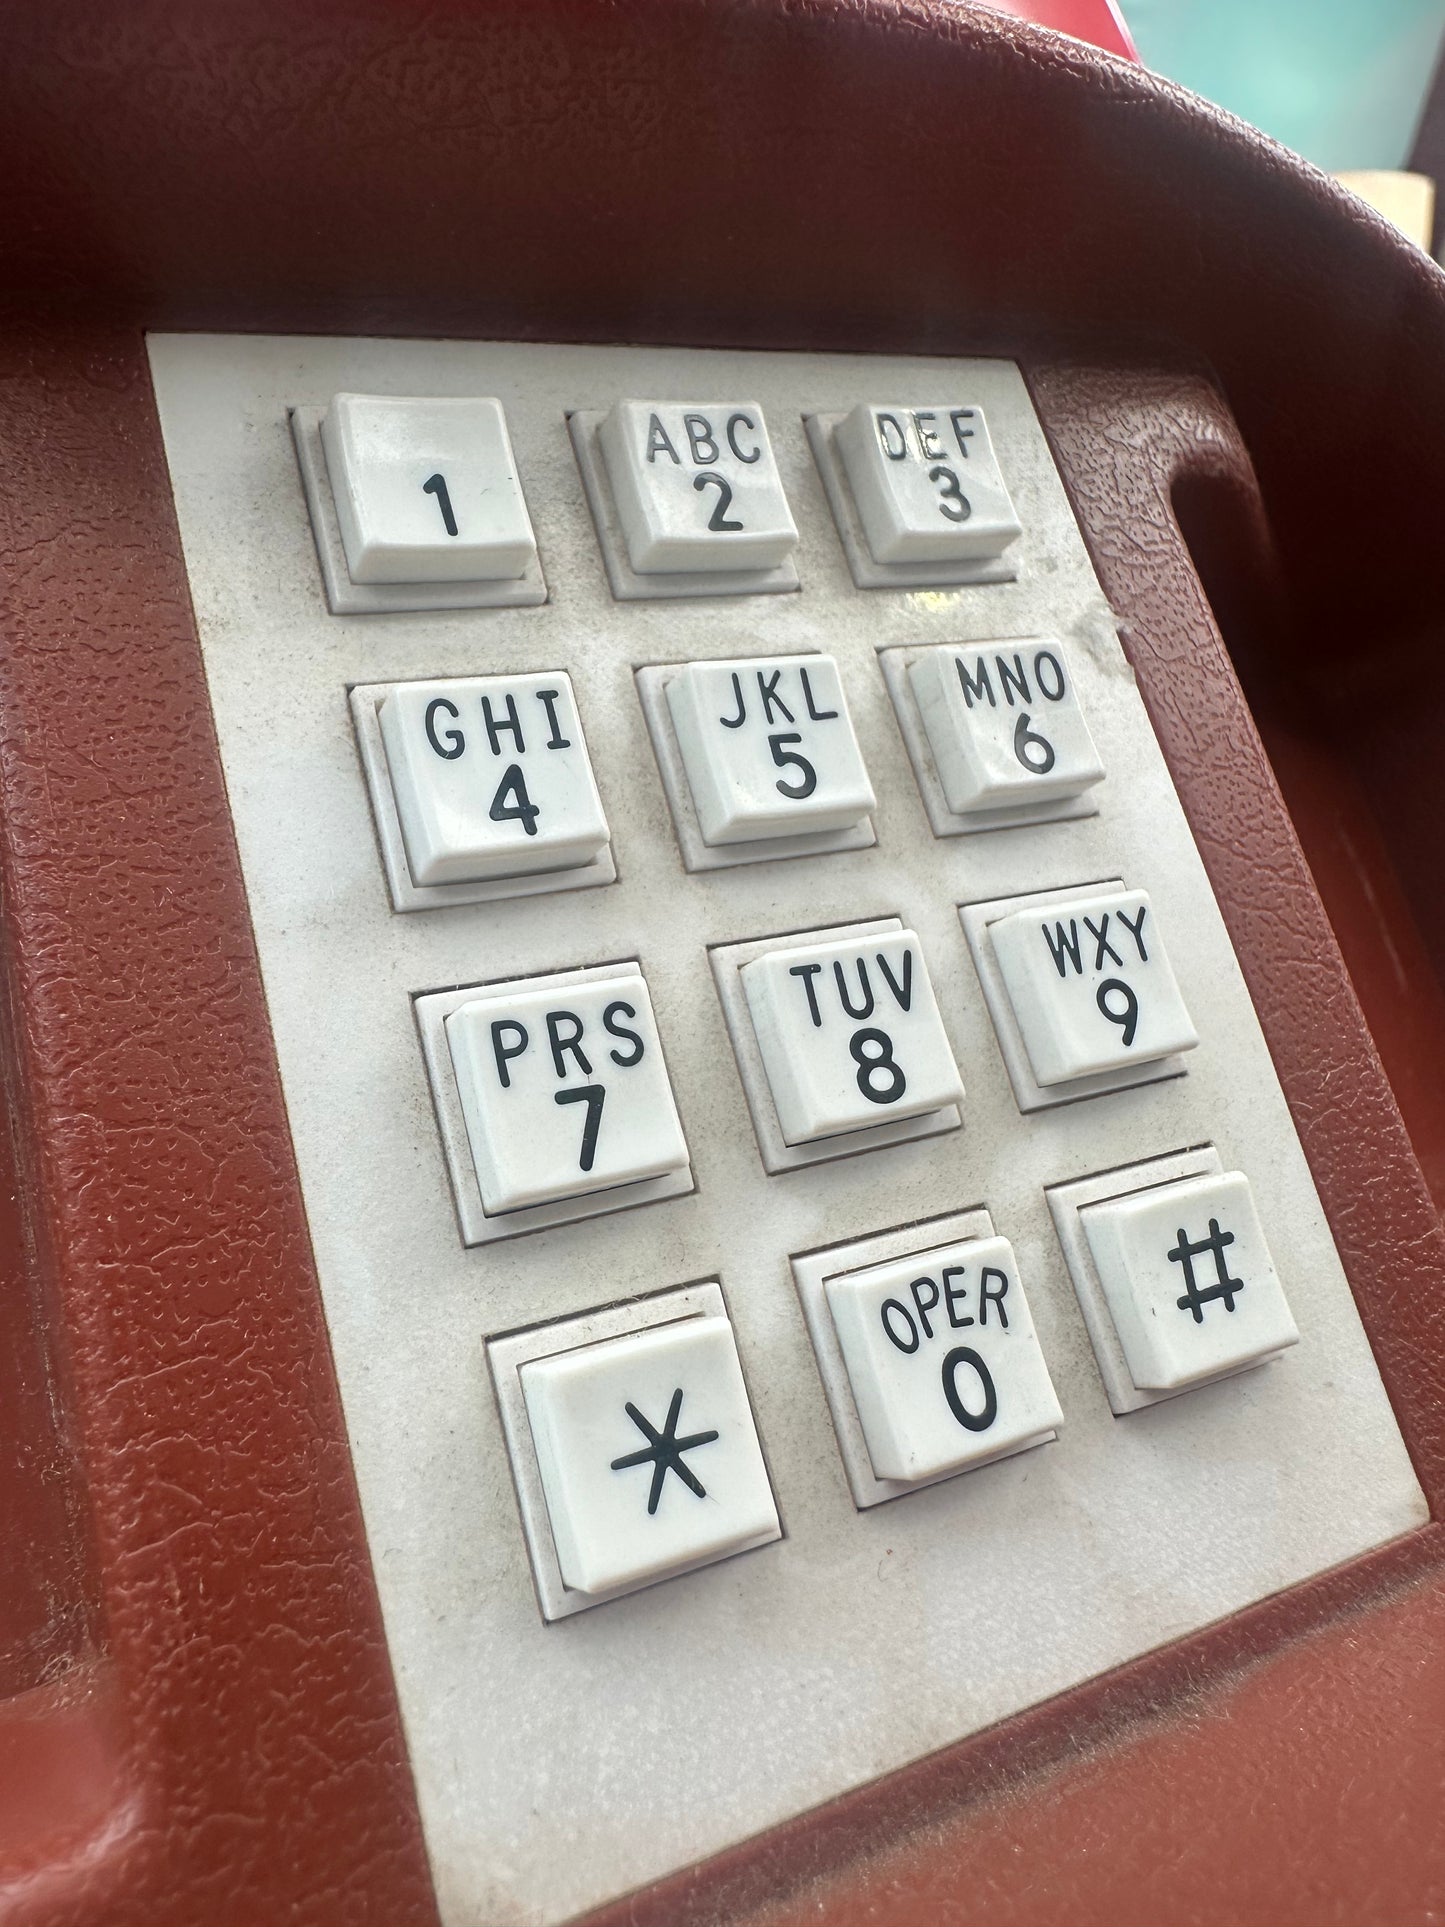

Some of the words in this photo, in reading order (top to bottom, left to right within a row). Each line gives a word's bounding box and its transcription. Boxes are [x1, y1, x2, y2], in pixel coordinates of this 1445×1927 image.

[646, 412, 761, 466] ABC
[876, 409, 975, 461] DEF
[422, 473, 459, 537] 1
[692, 472, 744, 532] 2
[927, 465, 972, 523] 3
[719, 667, 839, 728] JKL
[954, 650, 1066, 709] MNO
[424, 689, 571, 761] GHI
[1013, 712, 1056, 775] 6
[488, 763, 541, 836] 4
[767, 732, 818, 800] 5
[1041, 906, 1149, 978] WXY
[789, 949, 912, 1028] TUV
[1095, 978, 1139, 1047] 9
[490, 1000, 645, 1089] PRS
[849, 1027, 907, 1105] 8
[554, 1083, 606, 1172] 7
[1166, 1217, 1245, 1324] #
[880, 1265, 1009, 1355] OPER
[941, 1346, 998, 1433] 0
